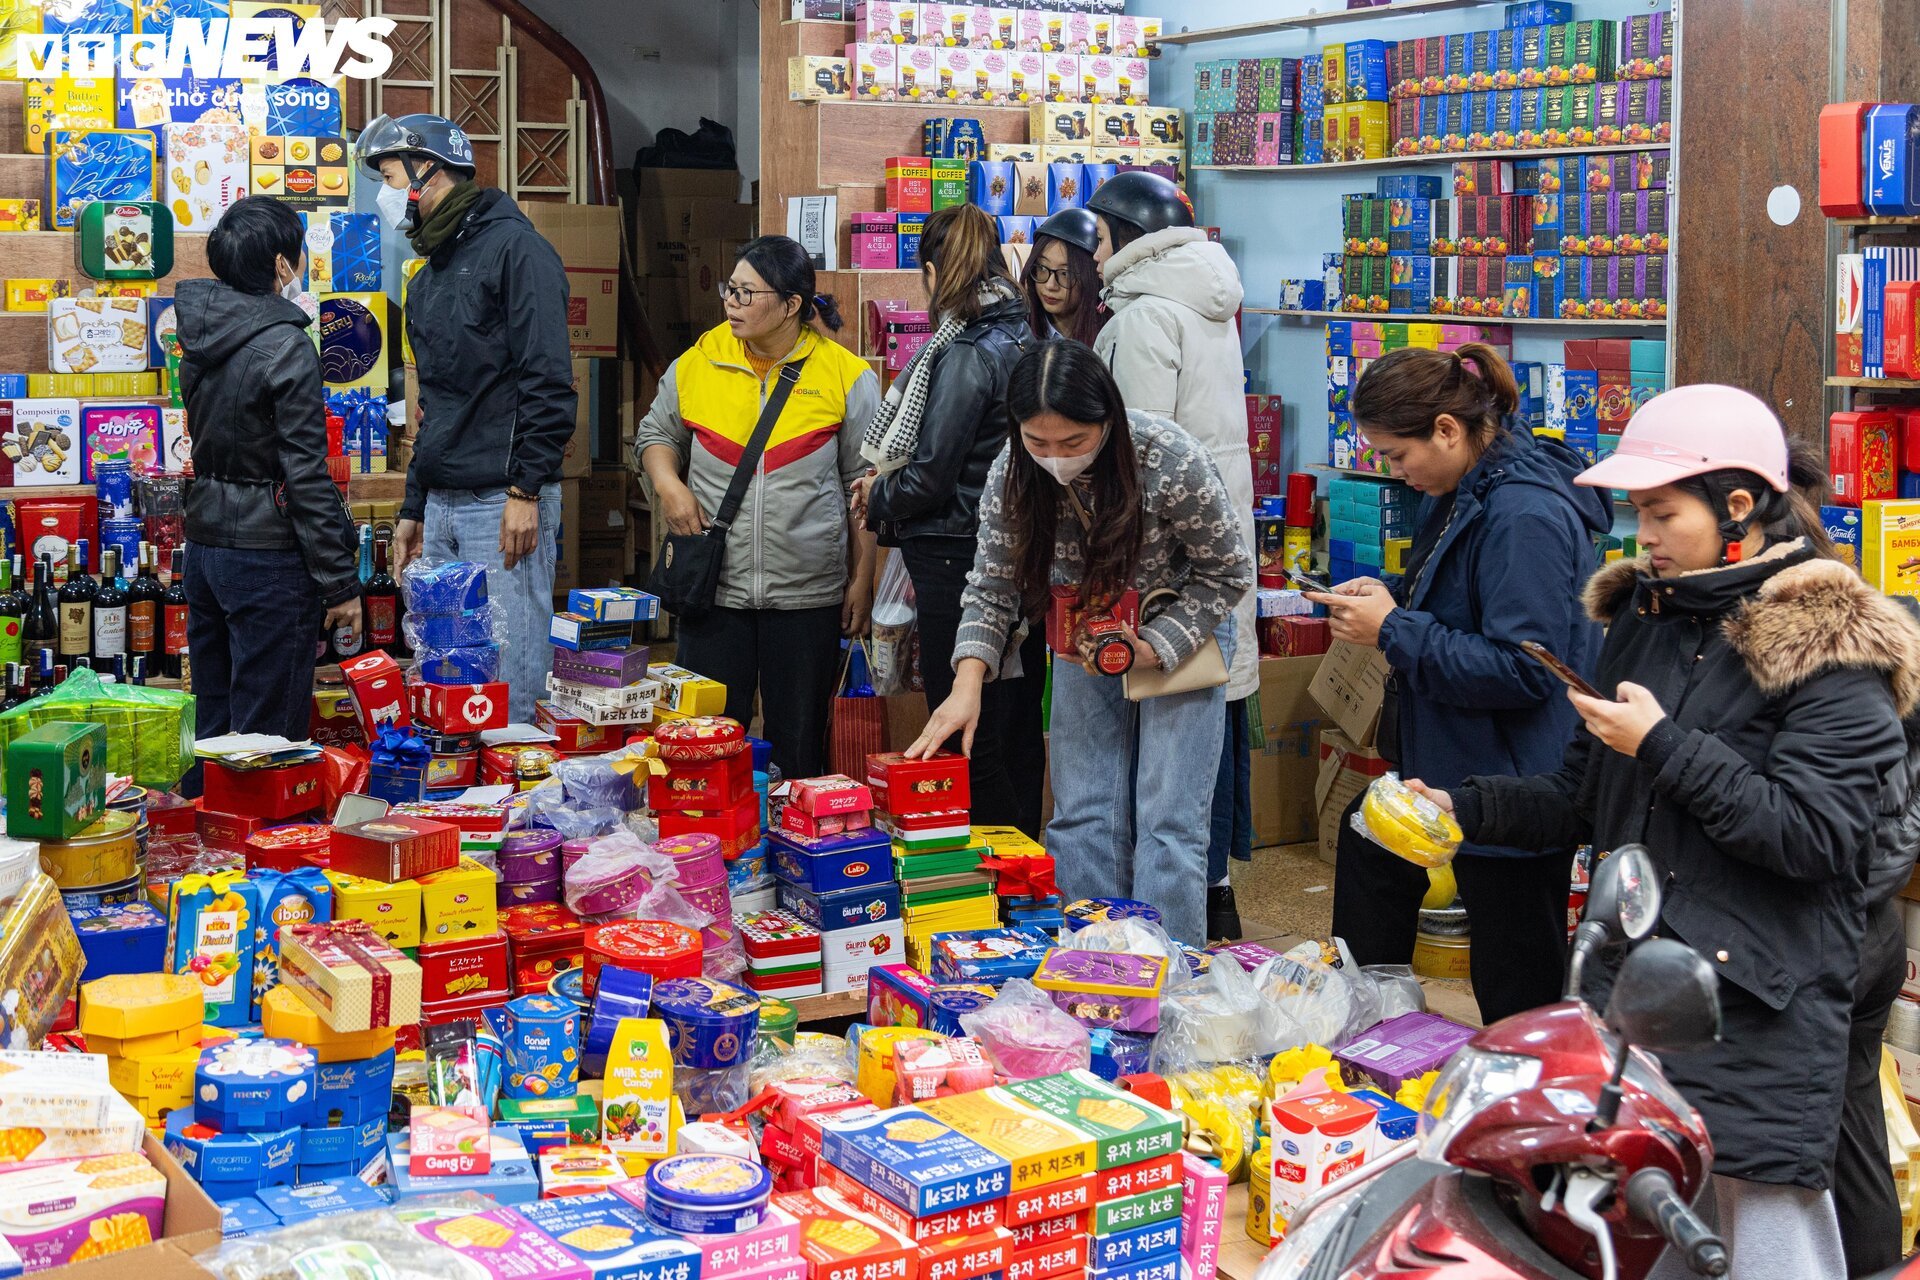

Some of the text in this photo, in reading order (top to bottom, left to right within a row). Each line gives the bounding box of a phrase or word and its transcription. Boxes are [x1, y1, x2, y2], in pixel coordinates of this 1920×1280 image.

[902, 168, 928, 176] COFFEE
[937, 170, 962, 178] COFFEE
[866, 223, 893, 232] COFFEE
[793, 388, 821, 396] HDBank
[16, 407, 71, 421] Composition
[1253, 415, 1274, 423] ROYAL
[277, 907, 310, 922] ibon
[524, 1035, 550, 1046] Bonart
[613, 1067, 663, 1080] Milk Soft
[622, 1079, 653, 1089] Candy
[233, 1088, 272, 1100] mercy
[307, 1136, 345, 1145] ASSORTED
[1106, 1130, 1173, 1162] 유자 치즈케
[210, 1156, 251, 1165] ASSORTED
[426, 1156, 459, 1172] Gang
[1017, 1151, 1086, 1182] 유자 치즈케
[1106, 1164, 1173, 1195] 유자 치즈케
[1016, 1185, 1087, 1219] 유자 치즈케
[1104, 1226, 1177, 1261] 유자 치즈케
[709, 1233, 789, 1270] 유자 치즈케
[1038, 1247, 1077, 1272] 치즈케
